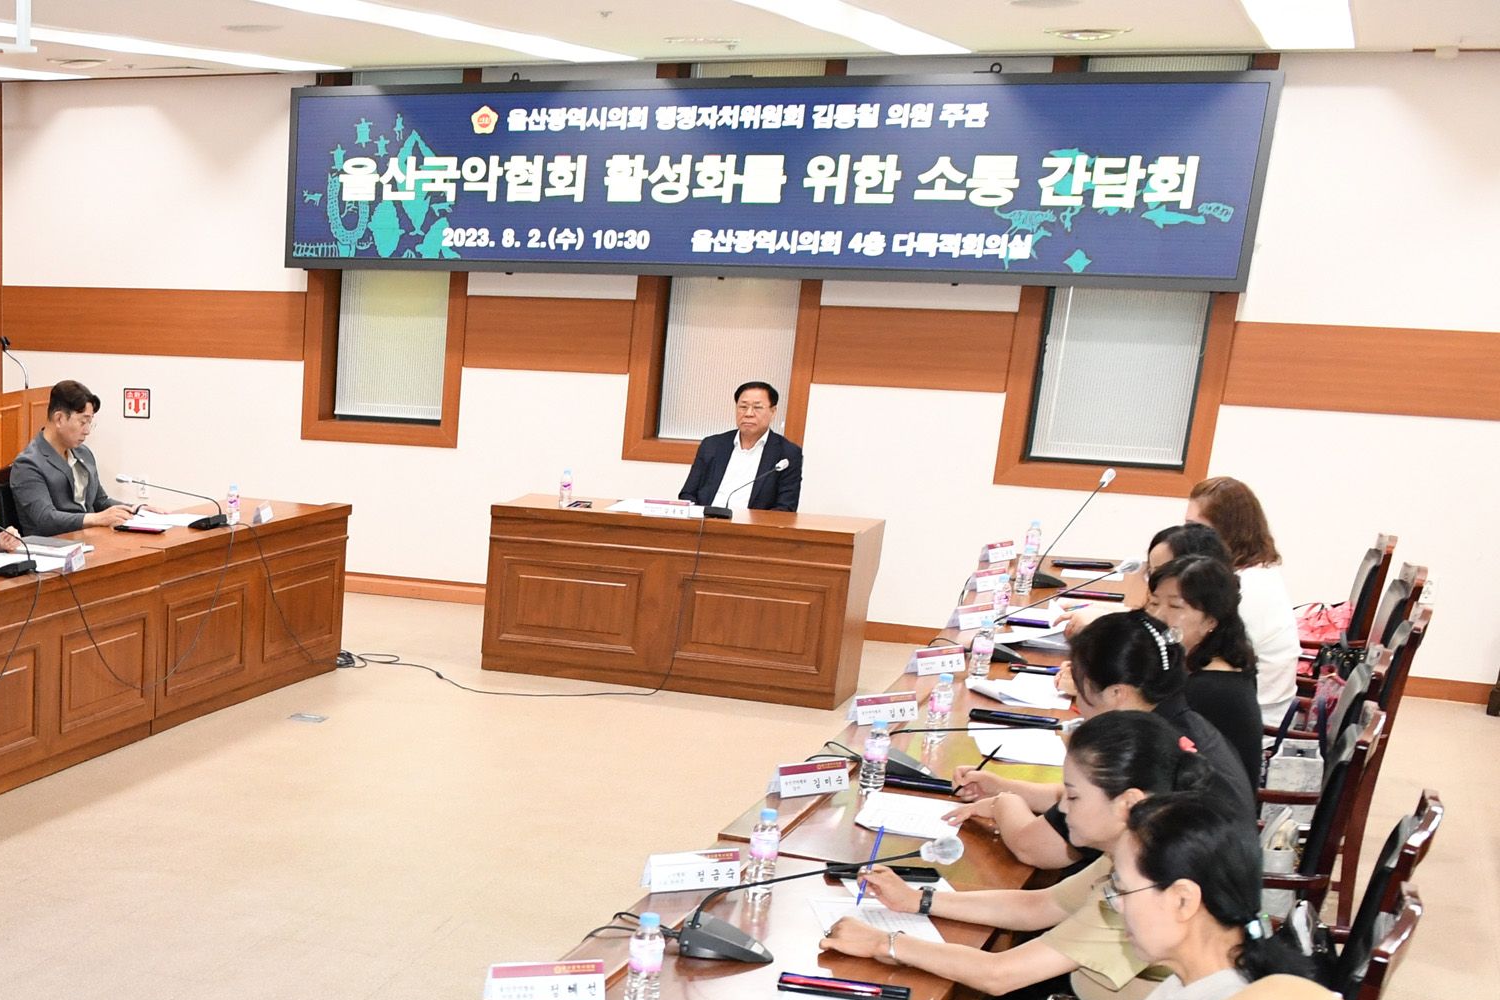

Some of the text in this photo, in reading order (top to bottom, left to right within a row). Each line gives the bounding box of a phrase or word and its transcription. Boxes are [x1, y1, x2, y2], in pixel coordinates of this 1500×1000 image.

[507, 106, 649, 131] 울산광역시의회
[655, 104, 806, 130] 행정자치위원회
[885, 103, 934, 129] 의원
[939, 102, 989, 128] 주관
[339, 154, 1200, 210] 울산국악협회 활성화를 위한 소통 간담회
[441, 227, 651, 251] 2023. 8. 2.(수) 10:30
[691, 229, 1033, 259] 울산광역시의회 4층 다목적회의실
